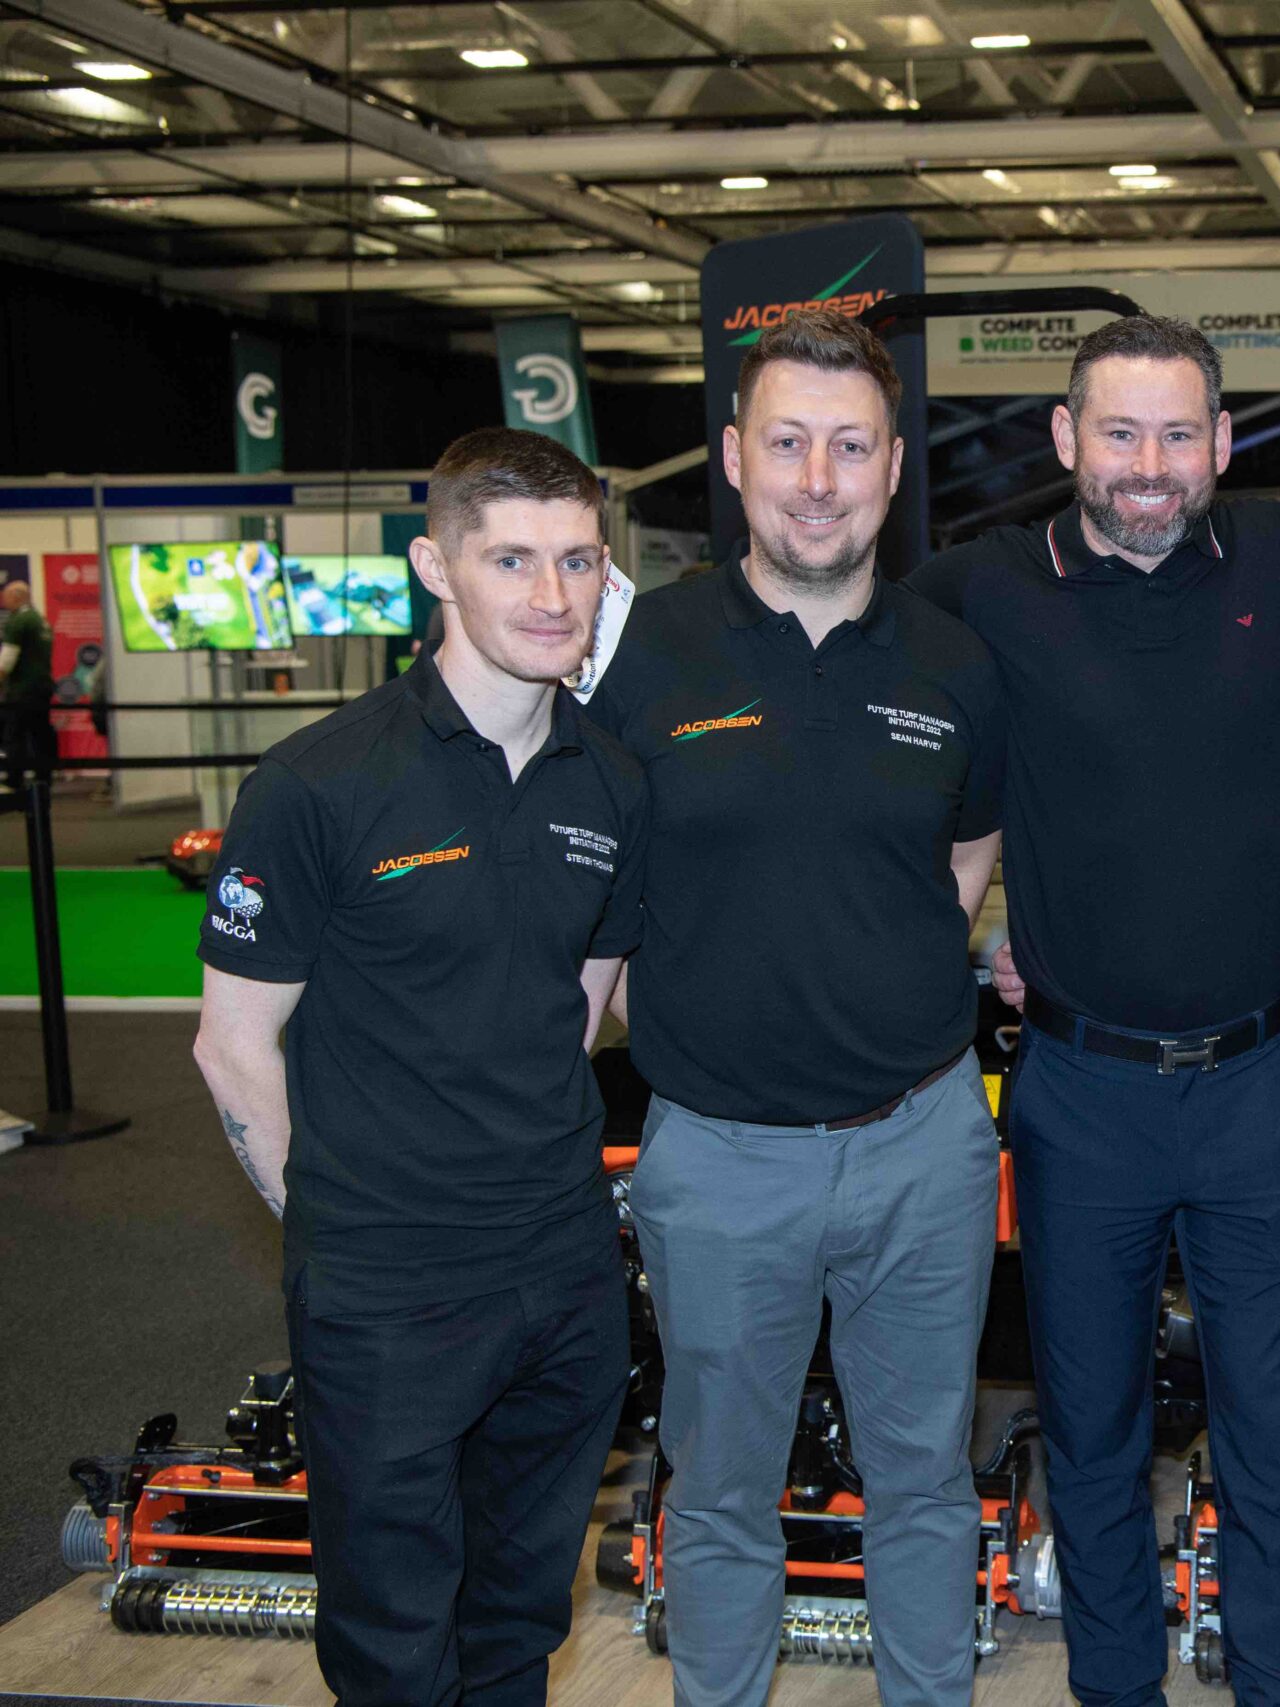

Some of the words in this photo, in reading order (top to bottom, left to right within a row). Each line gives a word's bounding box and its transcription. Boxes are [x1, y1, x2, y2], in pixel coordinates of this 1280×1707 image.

[981, 317, 1075, 333] COMPLETE
[982, 336, 1034, 352] WEED
[1038, 335, 1084, 352] CON
[671, 715, 762, 737] JACOBSEN
[867, 704, 898, 717] FUTURE
[898, 709, 918, 720] TURF
[919, 714, 955, 733] MANAGERS
[888, 717, 926, 731] INITIATIVE
[926, 725, 942, 736] 2022
[890, 732, 912, 744] SEAN
[913, 736, 942, 751] HARVEY
[549, 824, 579, 836] FUTURE
[372, 845, 470, 874] JACOBSEN
[566, 853, 592, 867] STEVEN
[212, 914, 256, 942] BIGGA
